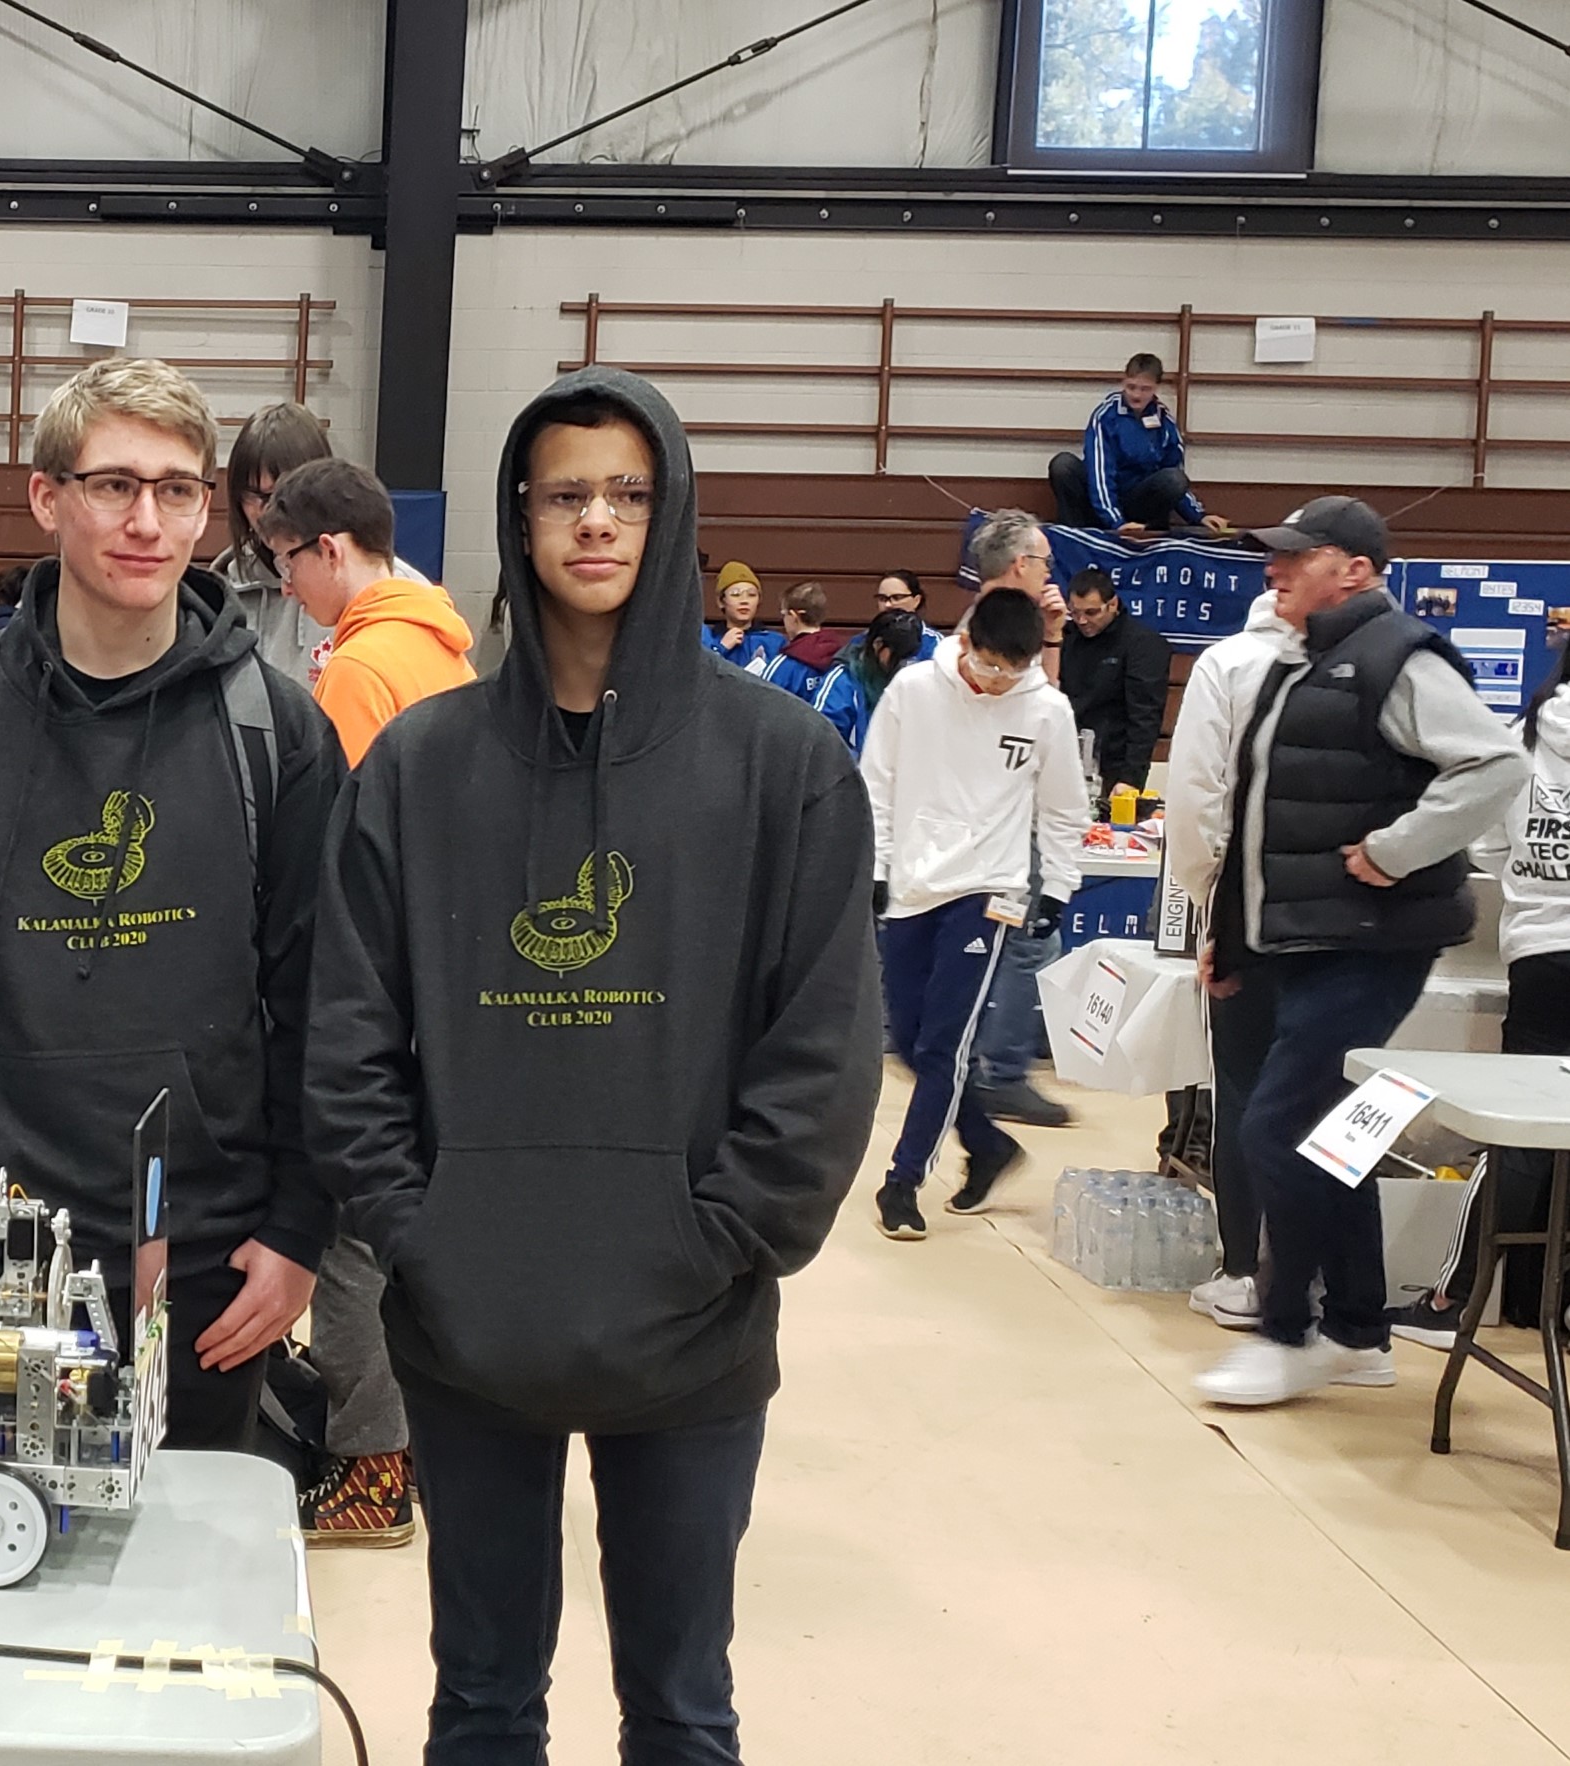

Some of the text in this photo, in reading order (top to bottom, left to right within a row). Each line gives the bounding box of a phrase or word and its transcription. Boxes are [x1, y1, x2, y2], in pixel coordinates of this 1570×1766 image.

[1087, 563, 1239, 592] ELMONT
[1131, 599, 1212, 621] YTES
[118, 906, 197, 928] ROBOTICS
[111, 930, 148, 947] 2020
[479, 988, 666, 1006] KALAMALKA ROBOTICS
[1085, 991, 1114, 1025] 16140
[527, 1010, 613, 1027] CLUB 2020
[1345, 1100, 1393, 1138] 16411
